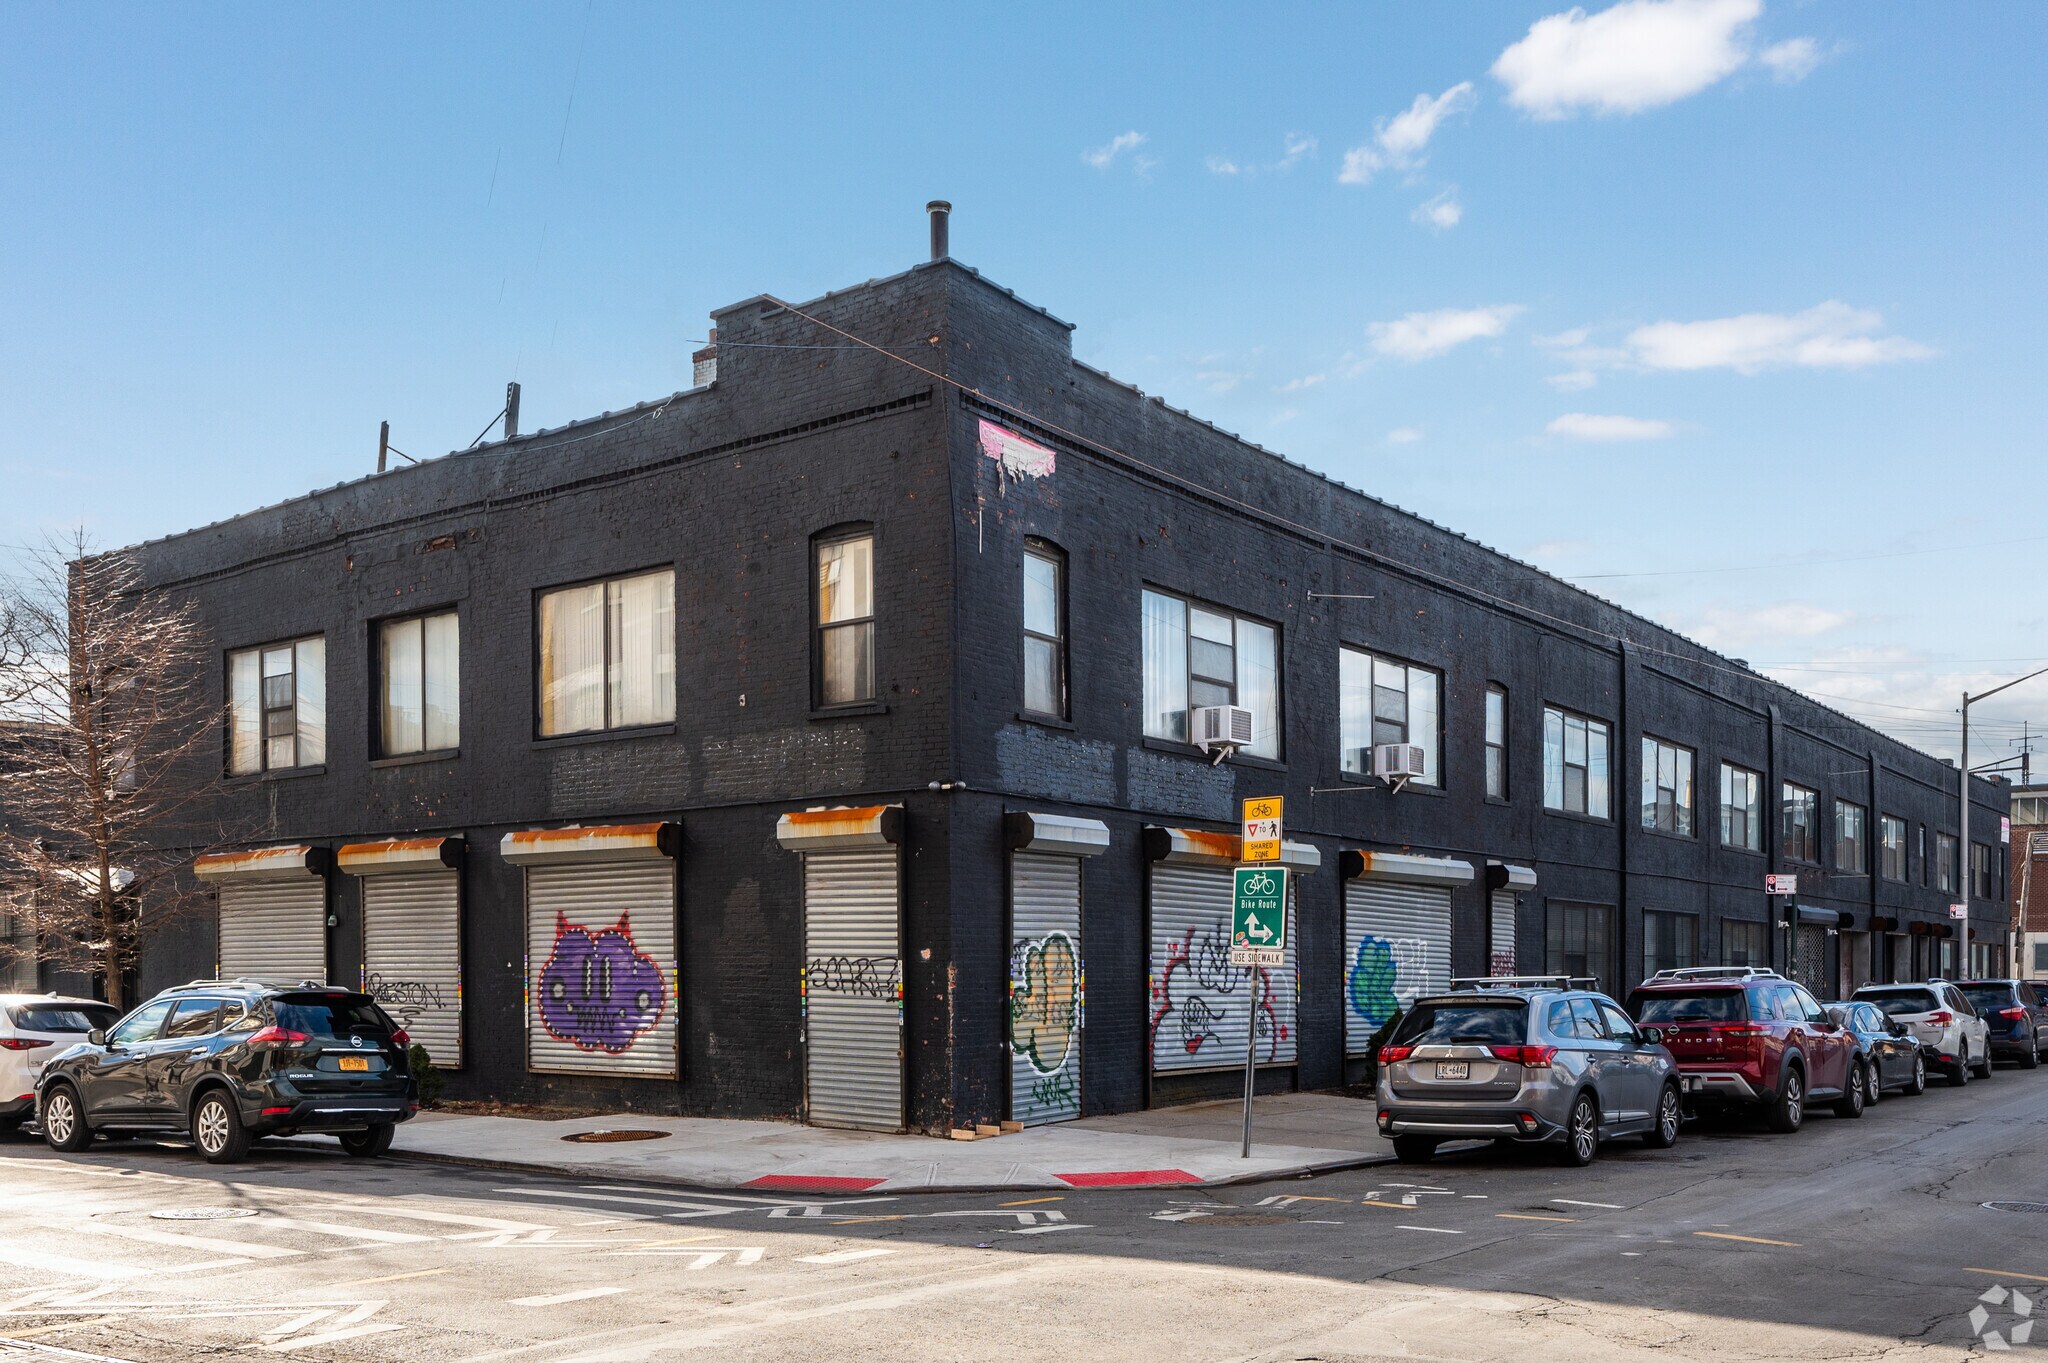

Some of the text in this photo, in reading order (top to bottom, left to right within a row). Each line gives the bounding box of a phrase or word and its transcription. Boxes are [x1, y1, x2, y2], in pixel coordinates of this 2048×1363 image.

[1250, 842, 1274, 851] SHARED
[1241, 899, 1277, 909] Bike Route
[1234, 953, 1280, 963] USE SIDEWALK
